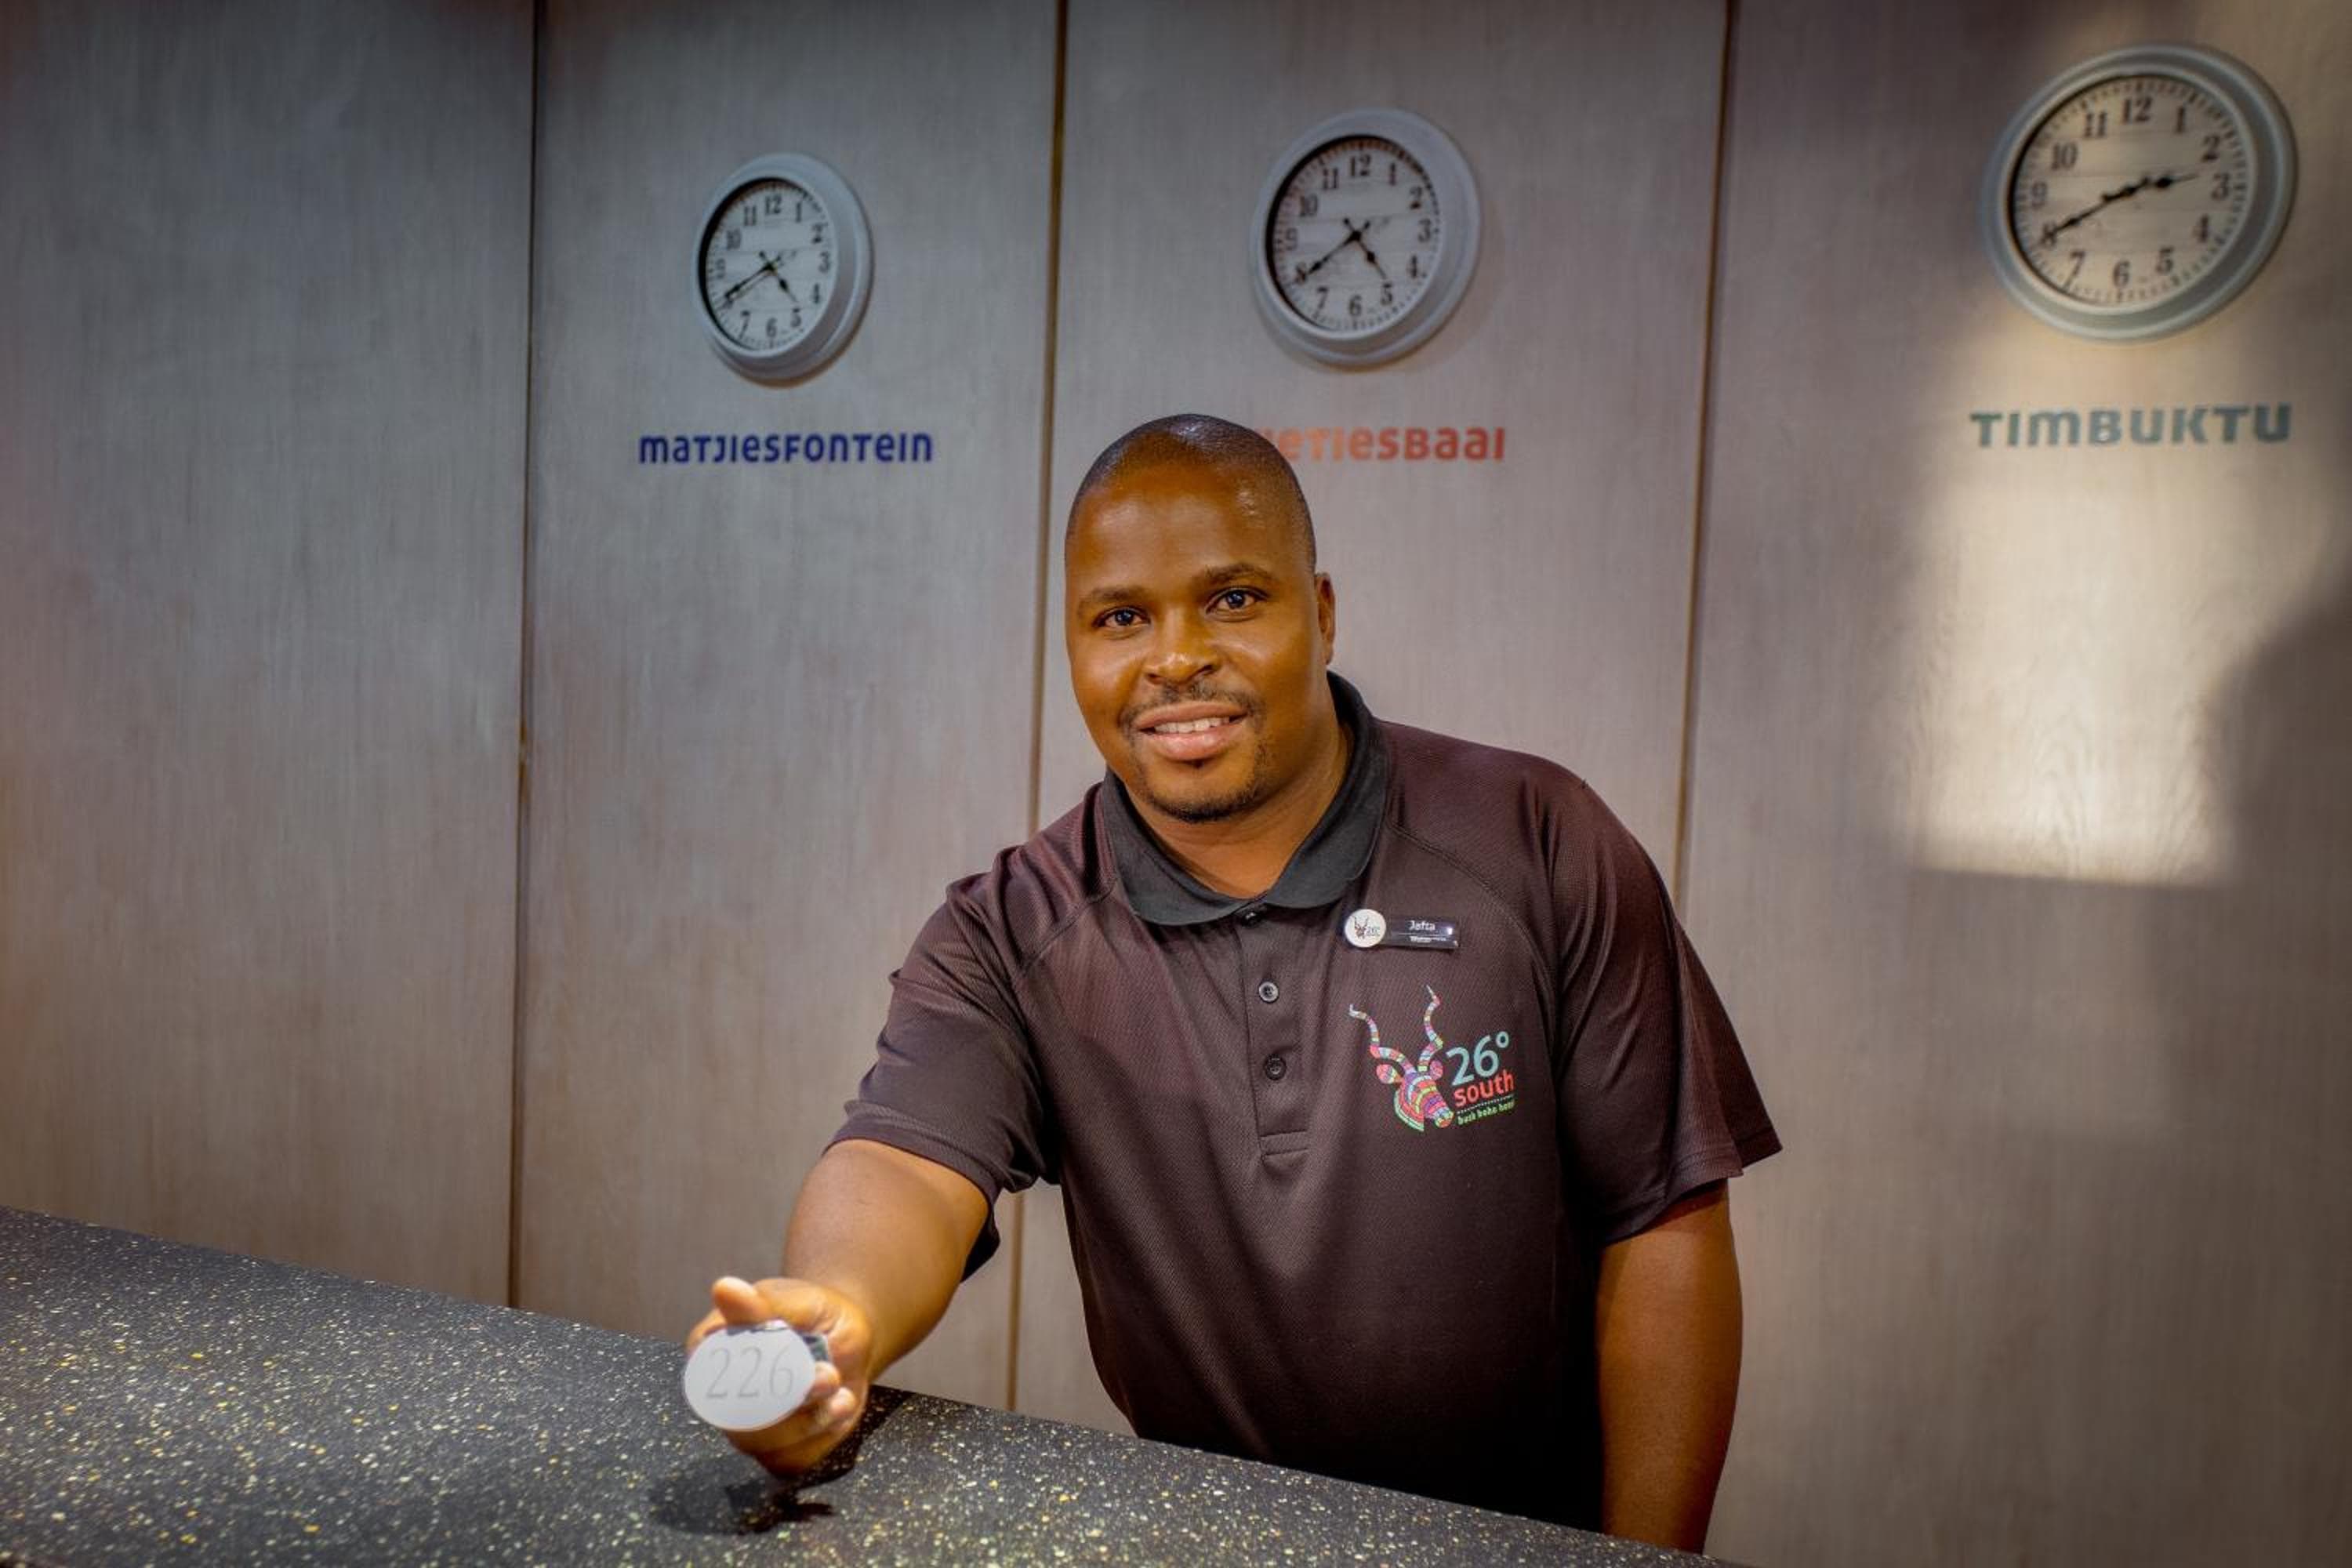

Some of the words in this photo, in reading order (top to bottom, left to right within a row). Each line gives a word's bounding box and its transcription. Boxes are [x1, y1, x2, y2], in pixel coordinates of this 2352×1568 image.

[2121, 97, 2152, 124] 12
[2175, 106, 2185, 133] 1
[2083, 112, 2107, 138] 11
[2052, 143, 2078, 170] 10
[2201, 135, 2221, 162] 2
[1349, 154, 1370, 177] 12
[1389, 163, 1396, 185] 1
[1323, 167, 1338, 190] 11
[2212, 172, 2230, 201] 3
[765, 194, 782, 215] 12
[1300, 194, 1318, 216] 10
[1410, 187, 1422, 209] 2
[2032, 183, 2048, 210] 9
[744, 205, 757, 226] 11
[796, 202, 802, 222] 1
[812, 223, 822, 244] 2
[1287, 227, 1297, 251] 9
[1419, 219, 1431, 242] 3
[2192, 214, 2209, 242] 4
[819, 251, 830, 273] 3
[1409, 255, 1418, 278] 4
[2070, 251, 2085, 276] 7
[2157, 247, 2173, 274] 5
[2113, 260, 2130, 287] 6
[812, 283, 820, 304] 4
[1317, 286, 1329, 310] 7
[1381, 282, 1392, 305] 5
[1349, 295, 1362, 317] 6
[767, 318, 777, 337] 6
[790, 308, 802, 328] 5
[1259, 426, 1506, 461] ETIESBAAI
[1454, 1069, 1515, 1107] south
[706, 1343, 794, 1400] 226
